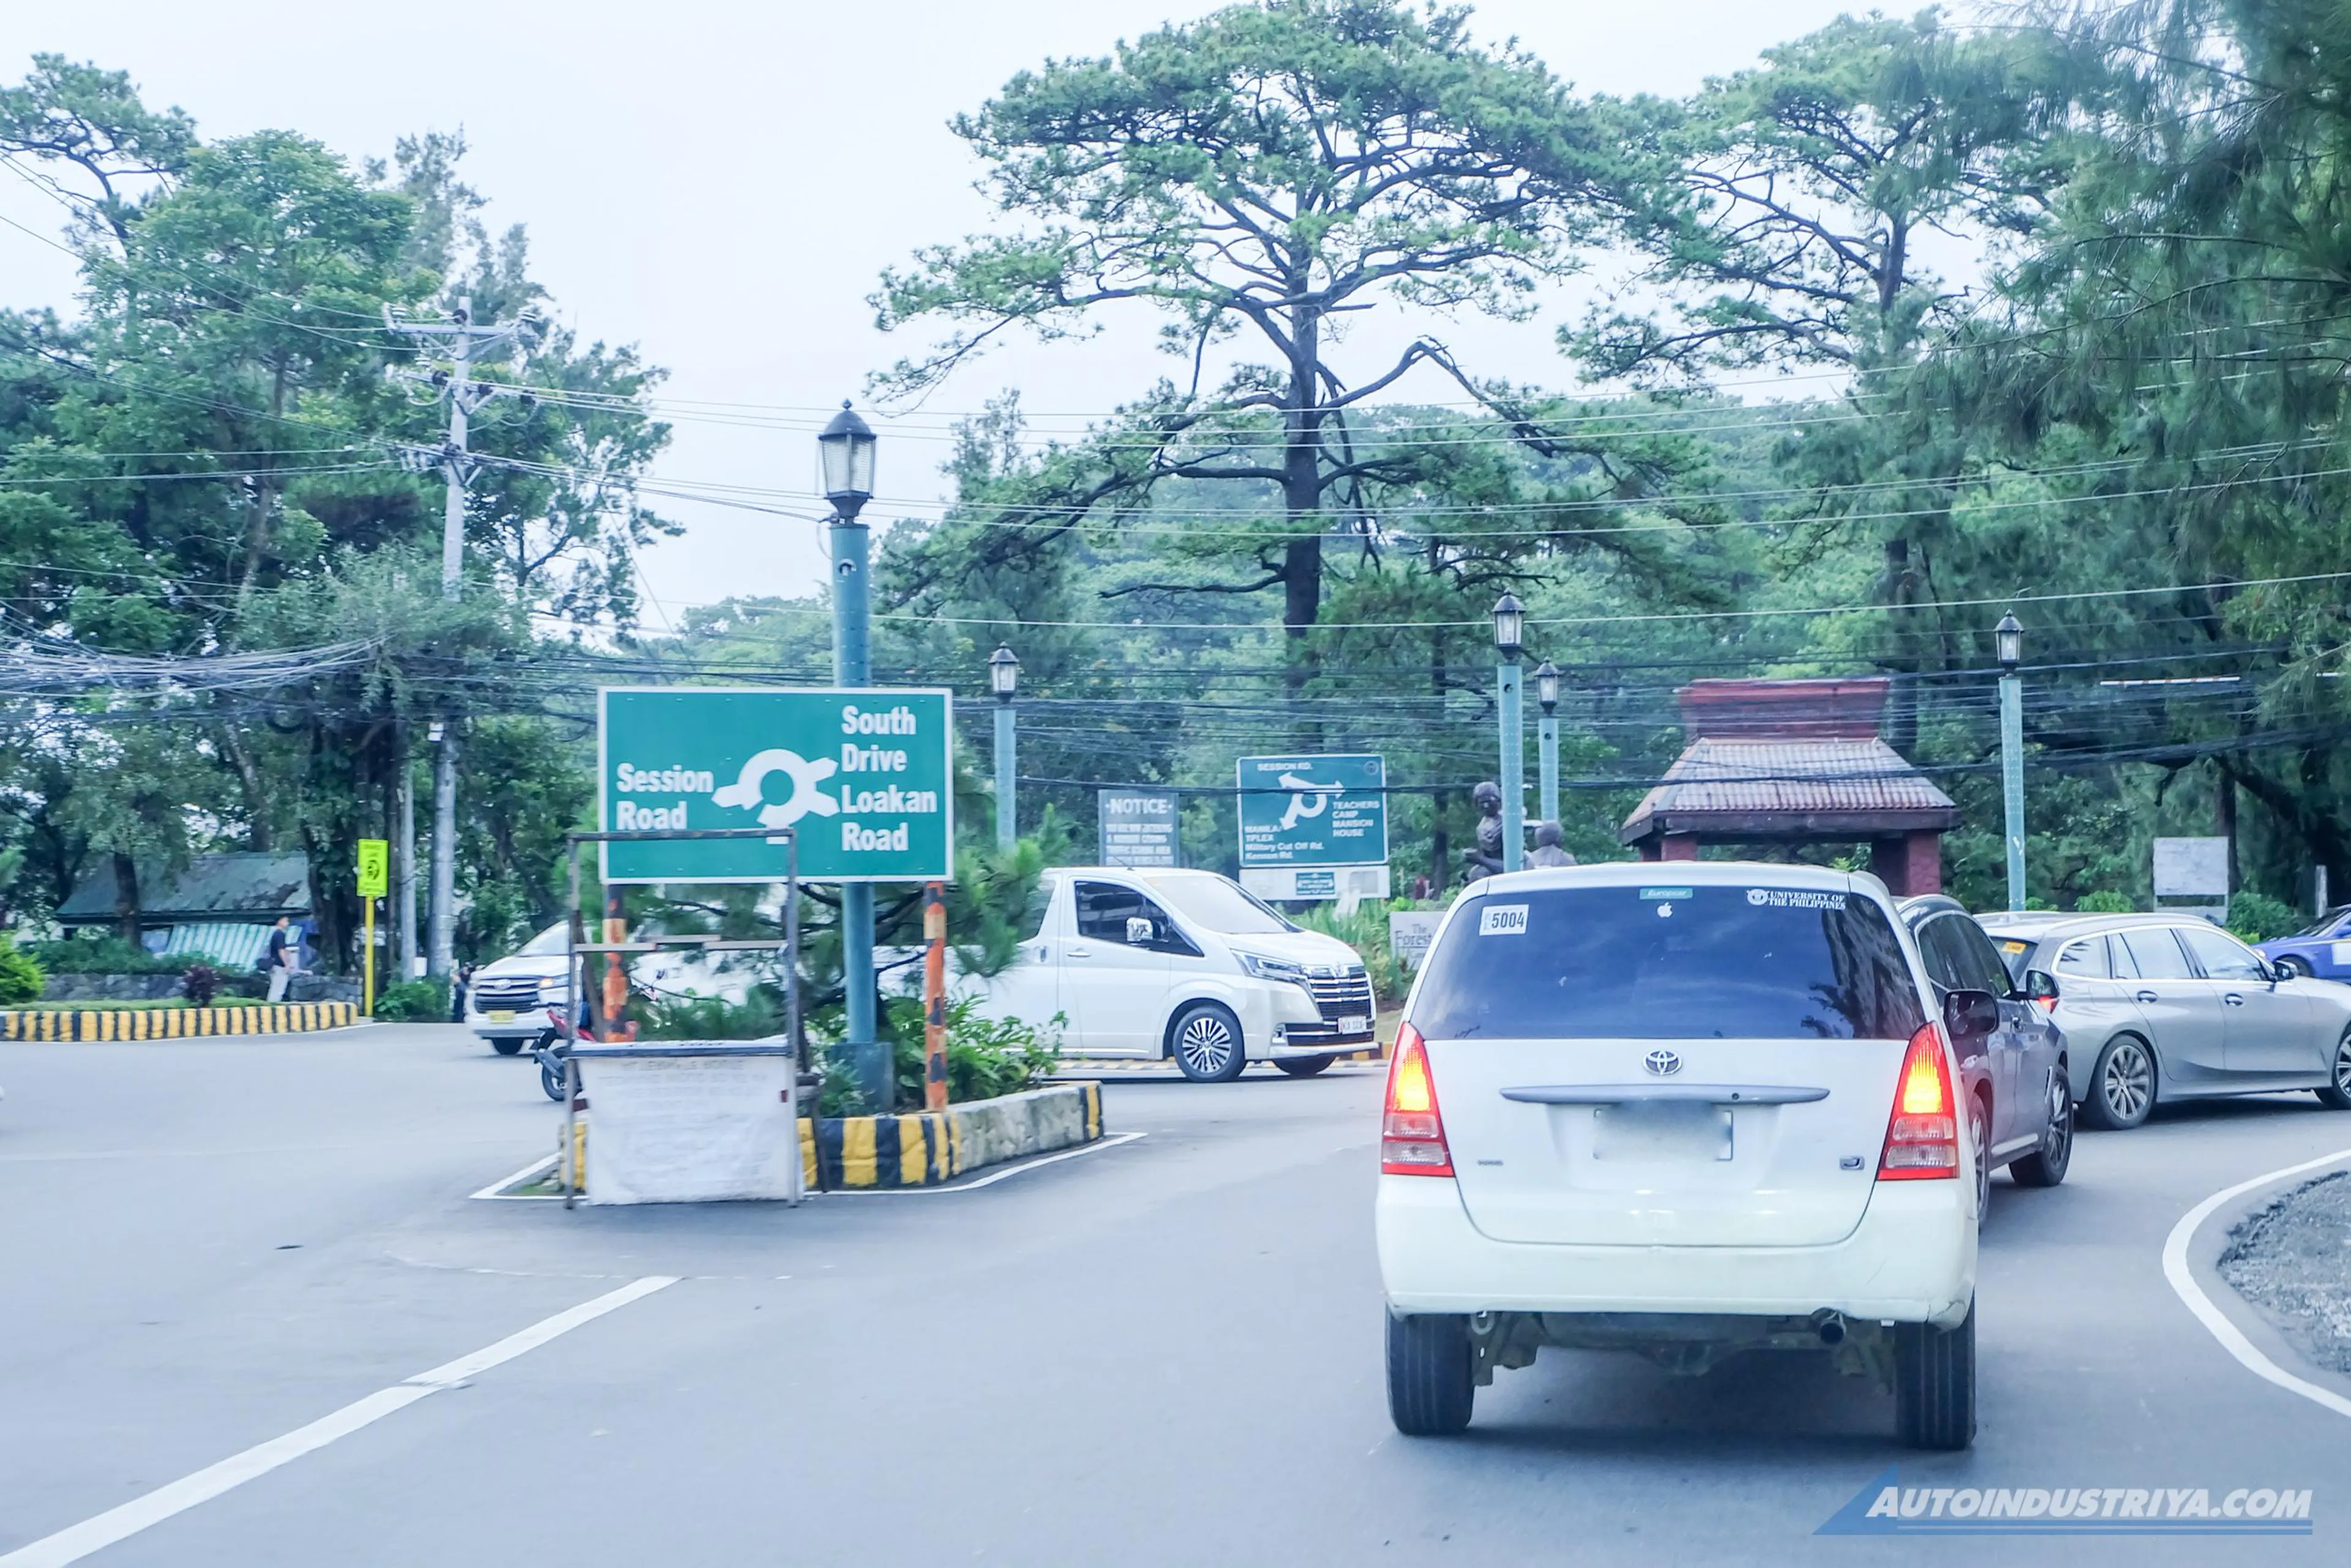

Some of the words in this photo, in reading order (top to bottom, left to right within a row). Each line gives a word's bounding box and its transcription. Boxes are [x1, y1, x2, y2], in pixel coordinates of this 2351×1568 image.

[841, 705, 916, 735] South
[841, 743, 907, 773] Drive
[1257, 762, 1296, 771] SESSION
[616, 762, 714, 793] Session
[841, 784, 937, 814] Loakan
[1109, 798, 1168, 814] NOTICE
[1332, 800, 1380, 809] TEACHERS
[616, 800, 688, 830] Road
[1332, 819, 1374, 828] MANSION
[841, 822, 909, 852] Road
[1332, 828, 1365, 838] HOUSE
[1769, 890, 1829, 901] UNIVERSITY
[1768, 898, 1787, 907] THE
[1789, 898, 1846, 910] PHILIPPINES
[1491, 911, 1525, 929] 5004
[1412, 923, 1428, 934] The
